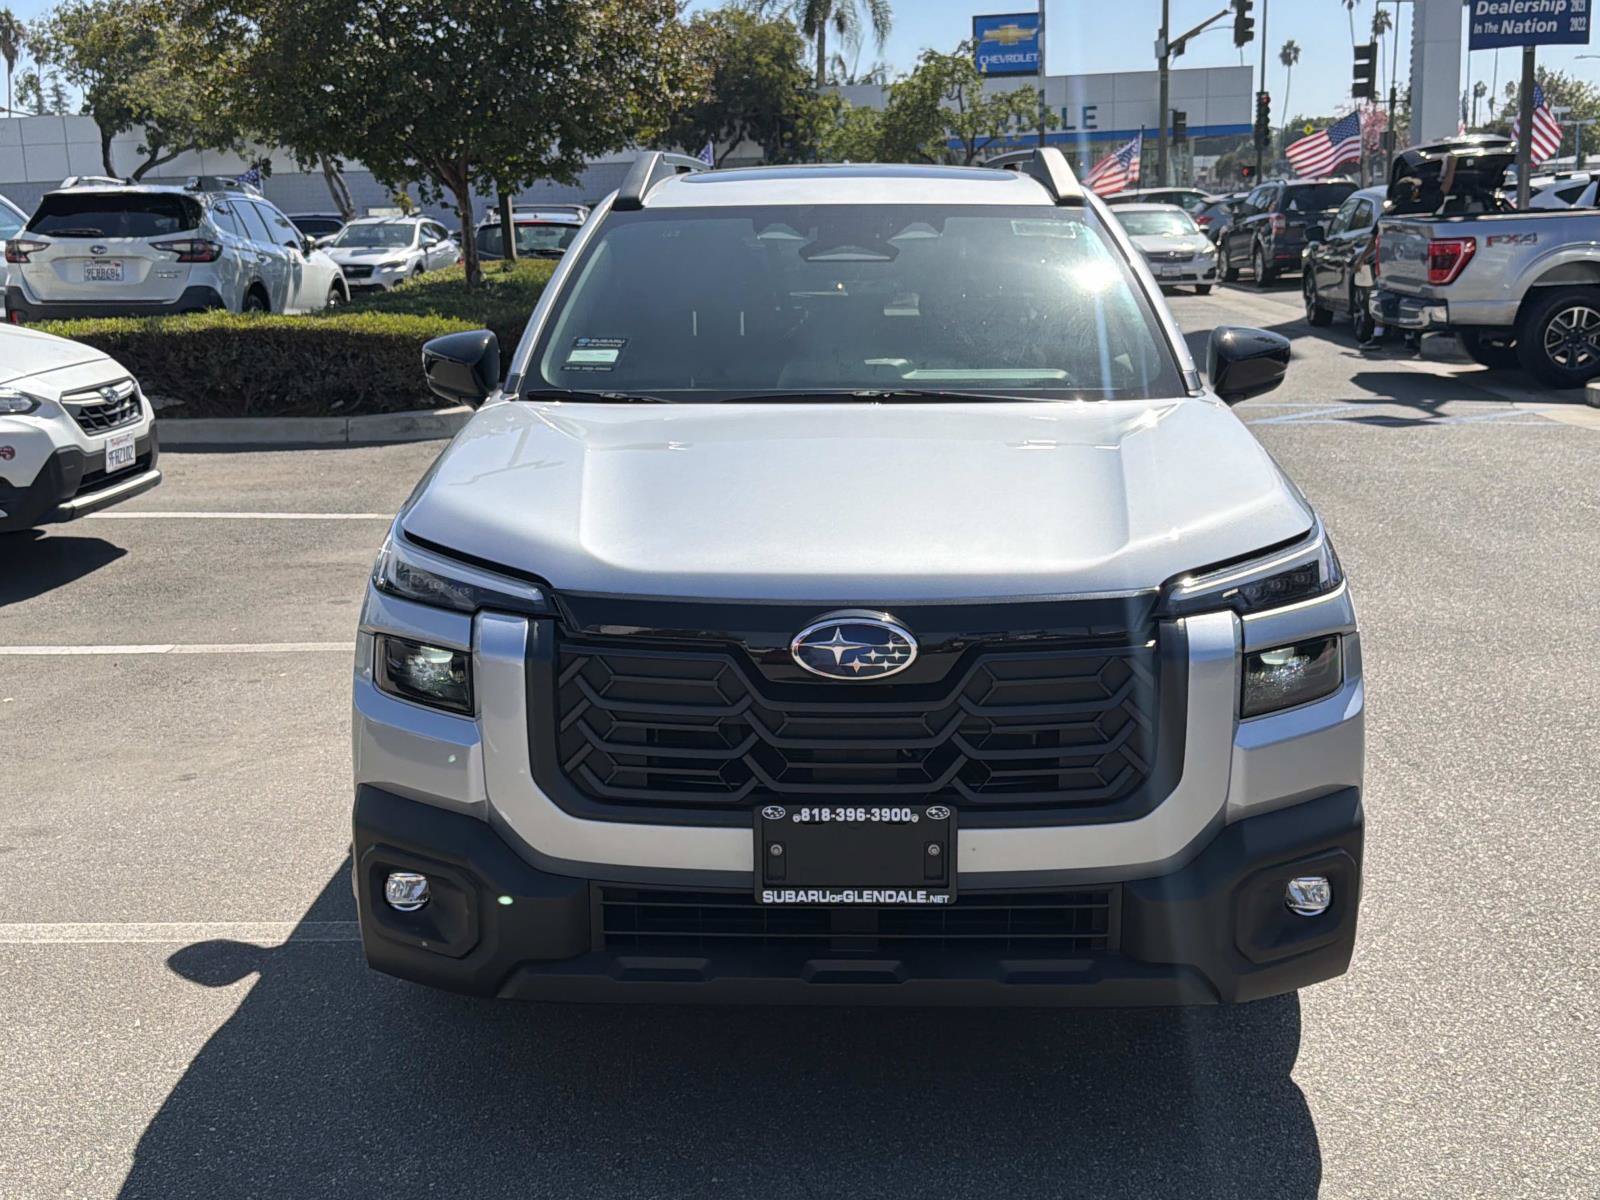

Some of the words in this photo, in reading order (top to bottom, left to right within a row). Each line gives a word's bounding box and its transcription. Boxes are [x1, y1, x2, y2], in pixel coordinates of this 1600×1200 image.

[1476, 0, 1566, 15] Dealership
[1473, 24, 1483, 34] In
[1484, 22, 1499, 33] The
[1500, 18, 1558, 34] Nation
[1569, 17, 1586, 31] 2022
[979, 53, 1038, 64] CHEVROLET
[1486, 232, 1538, 248] FX4
[801, 808, 911, 822] 818-396-3900
